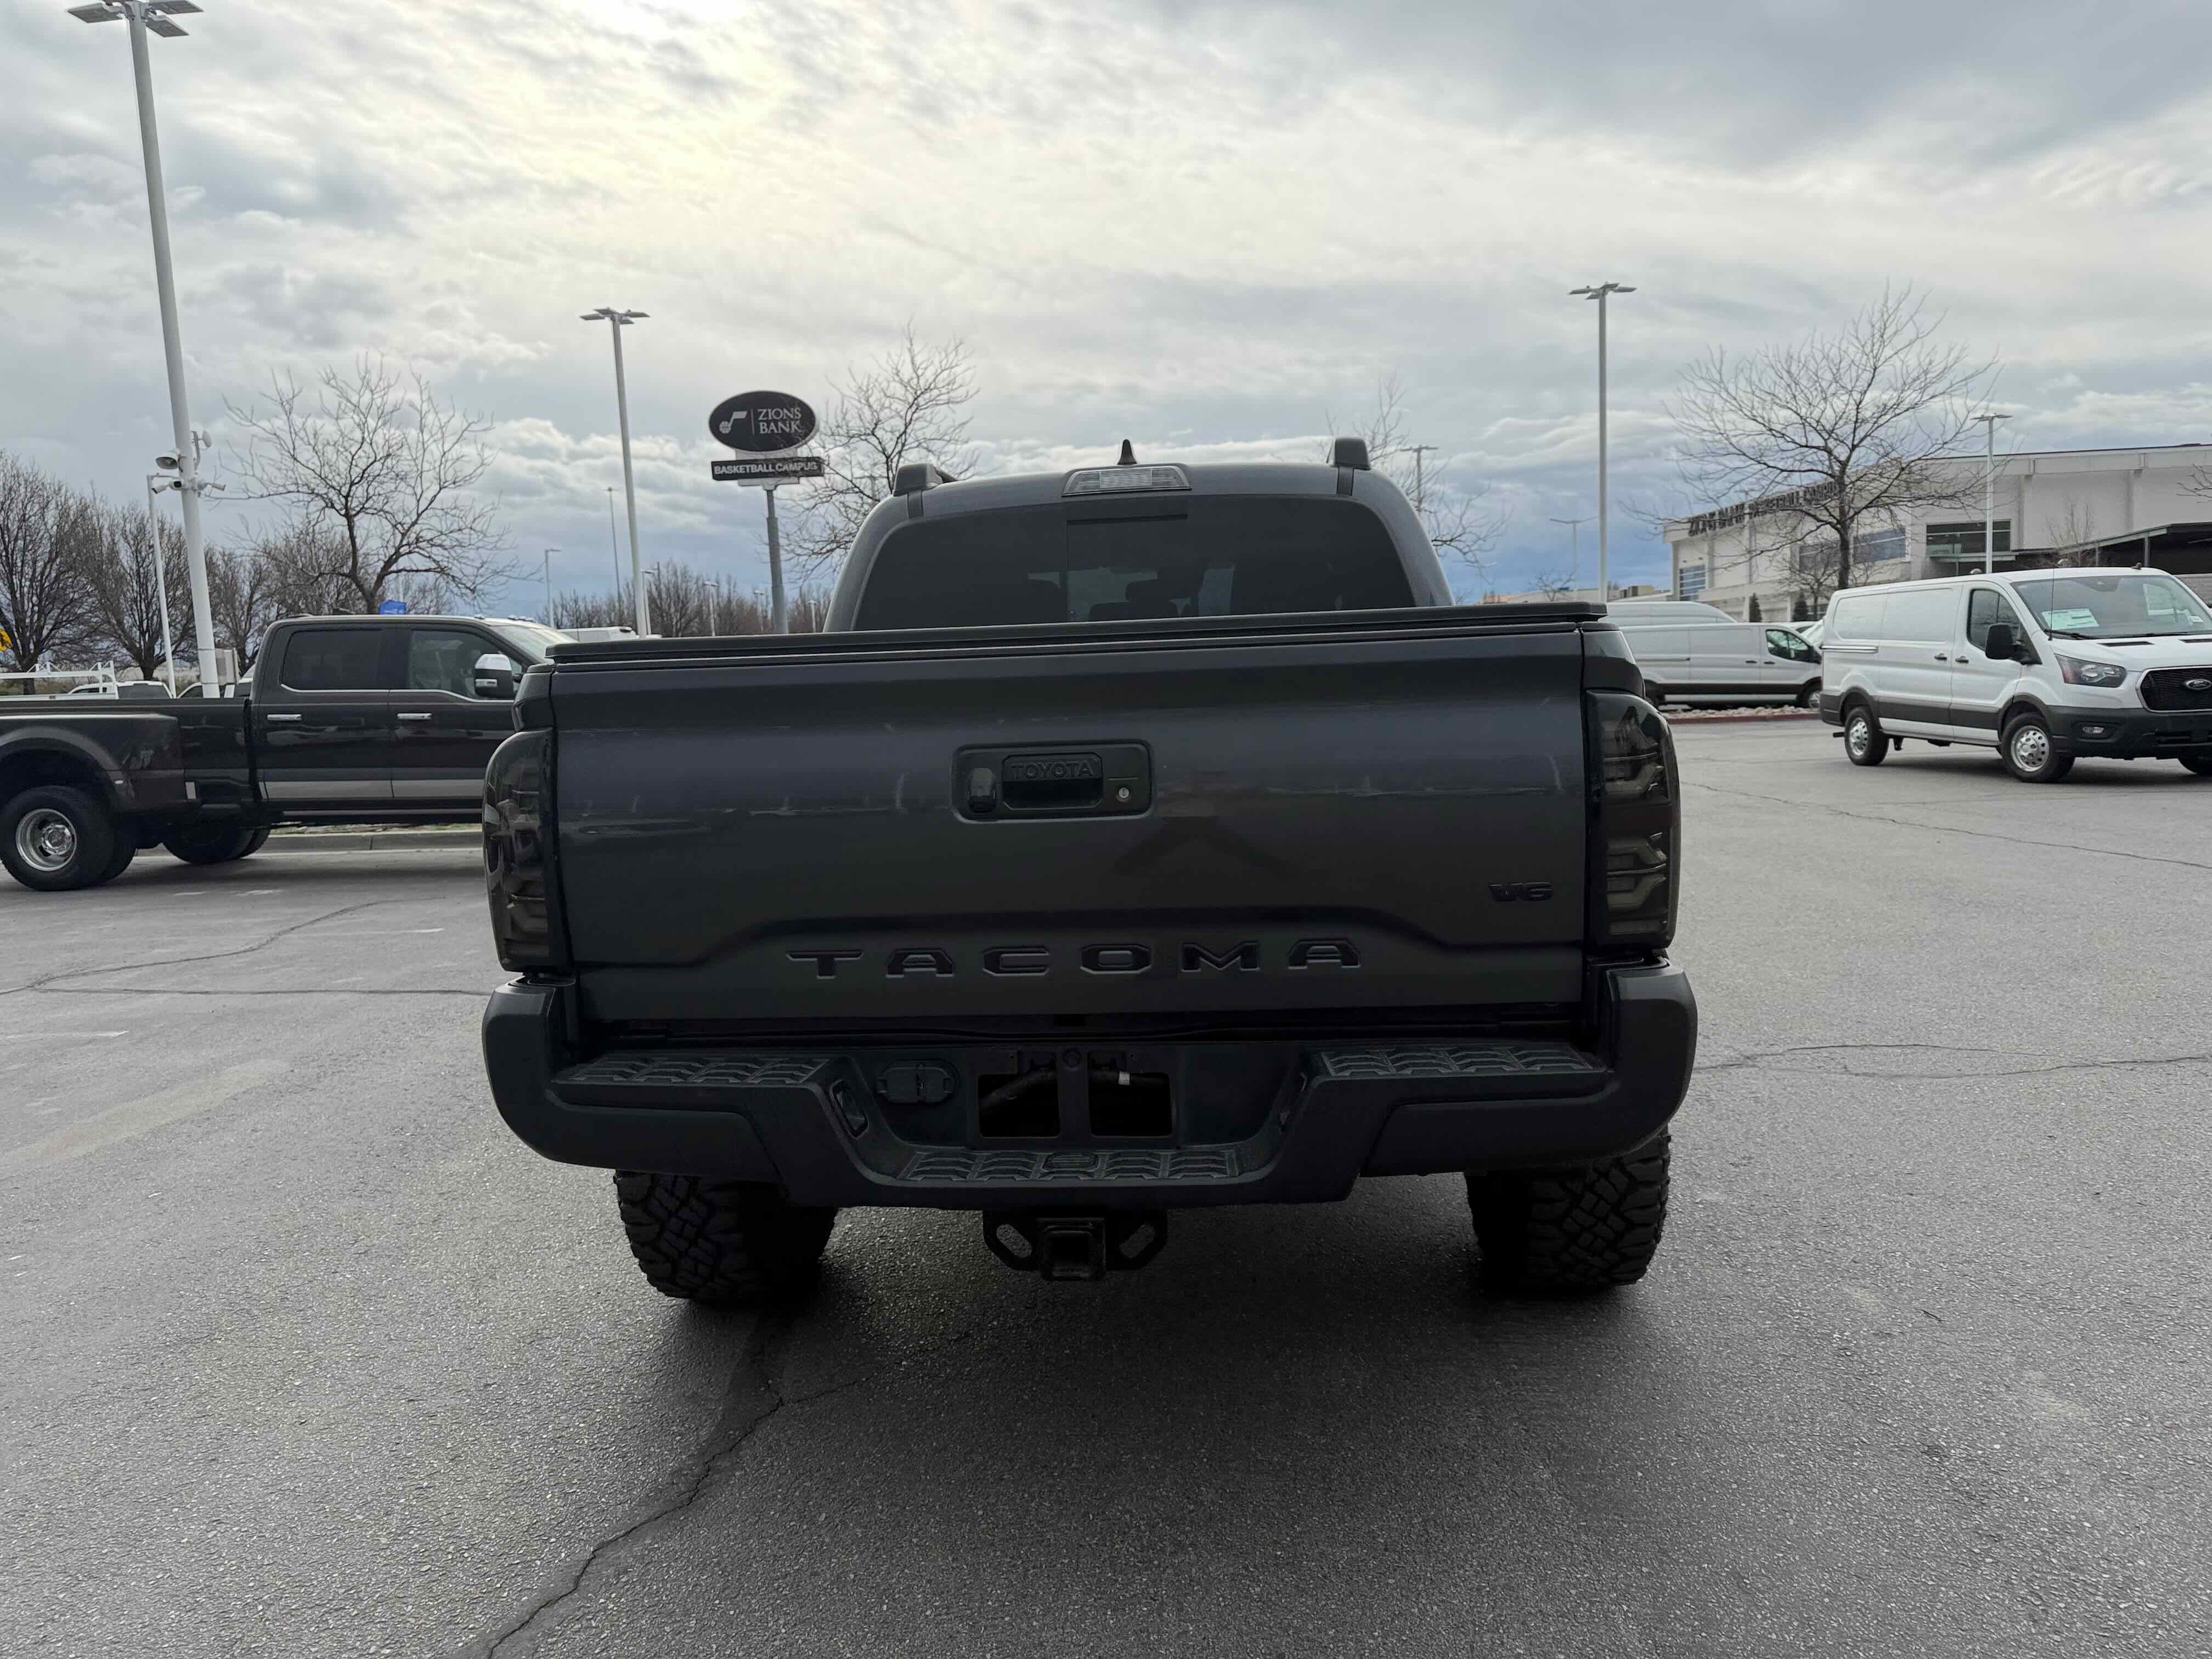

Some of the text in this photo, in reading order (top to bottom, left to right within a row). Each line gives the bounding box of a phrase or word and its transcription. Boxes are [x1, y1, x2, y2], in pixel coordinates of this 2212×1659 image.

[758, 408, 802, 421] ZIONS
[759, 421, 802, 435] BANK
[714, 462, 818, 475] BASKETBALL CAMPUS
[1009, 760, 1093, 778] TOYOTA
[1487, 882, 1554, 901] V6
[786, 938, 1361, 979] TACOMA
